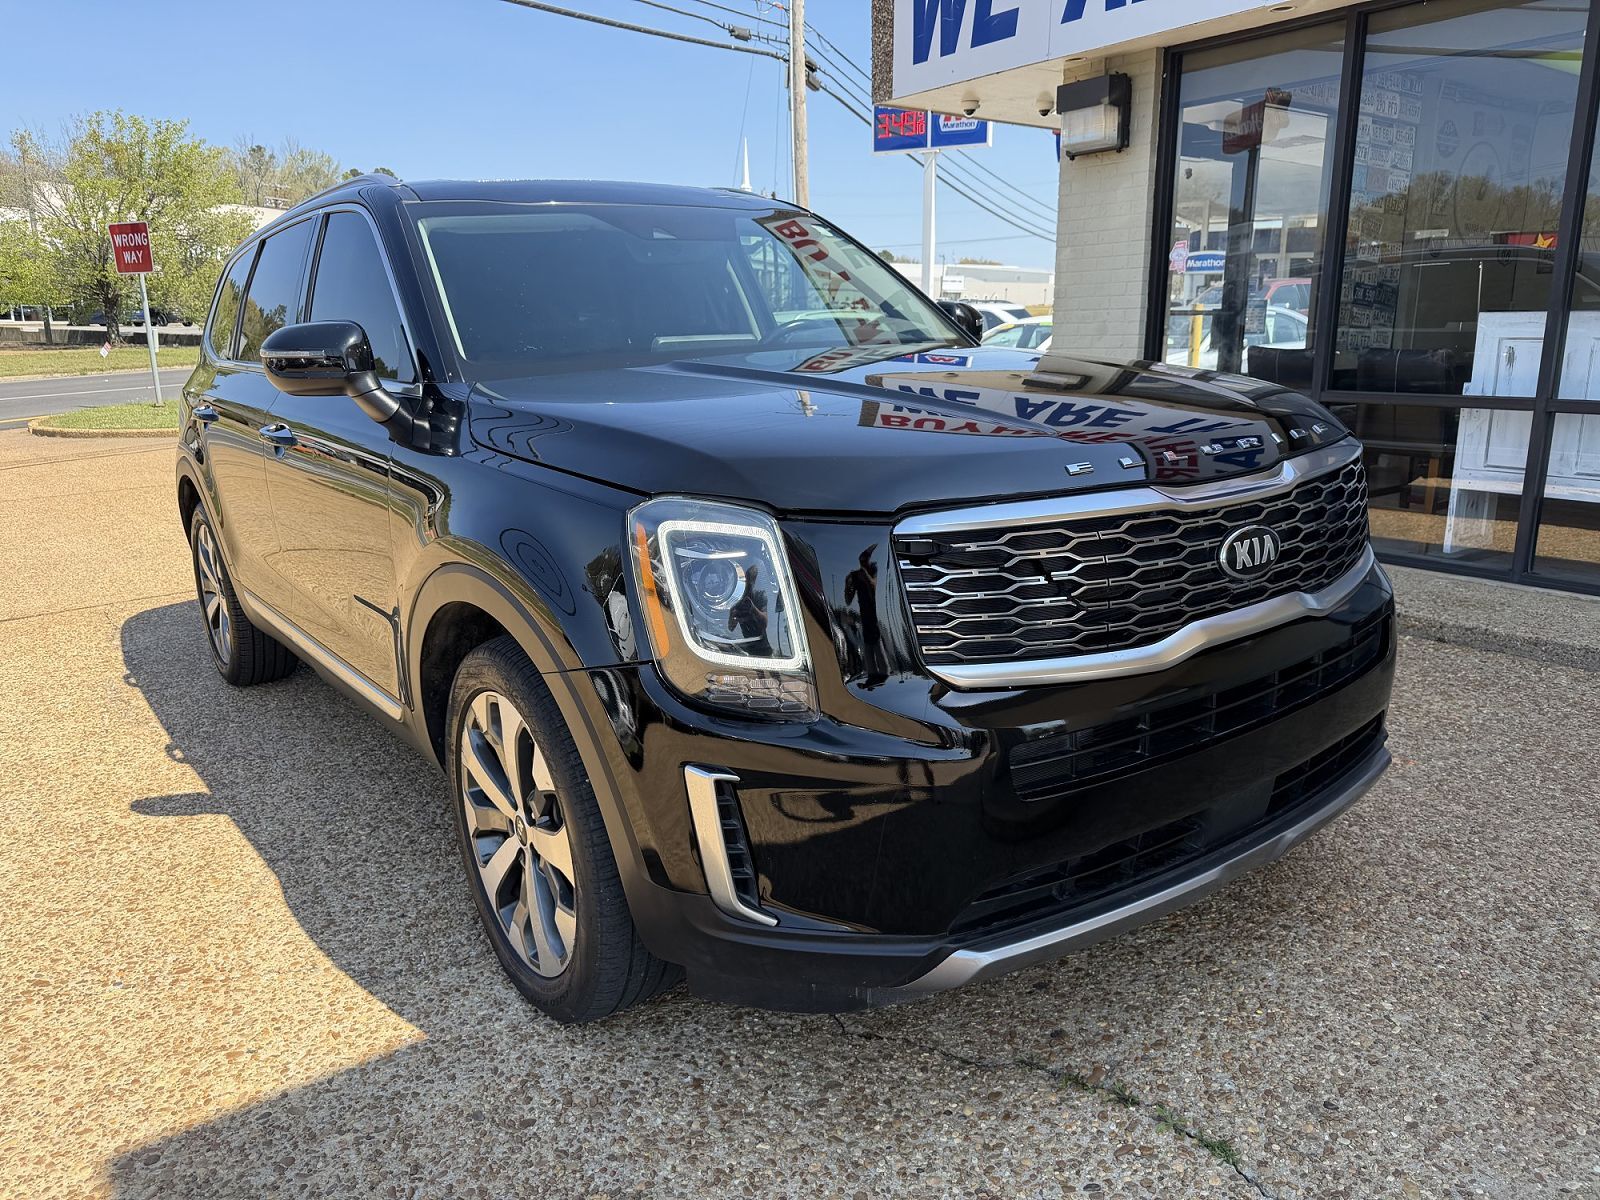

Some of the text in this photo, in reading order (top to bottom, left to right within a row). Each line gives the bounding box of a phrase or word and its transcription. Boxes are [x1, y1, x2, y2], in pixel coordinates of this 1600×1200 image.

[942, 121, 976, 129] Marathon
[113, 232, 148, 247] WRONG
[122, 250, 143, 264] WAY
[1233, 534, 1276, 570] KIA
